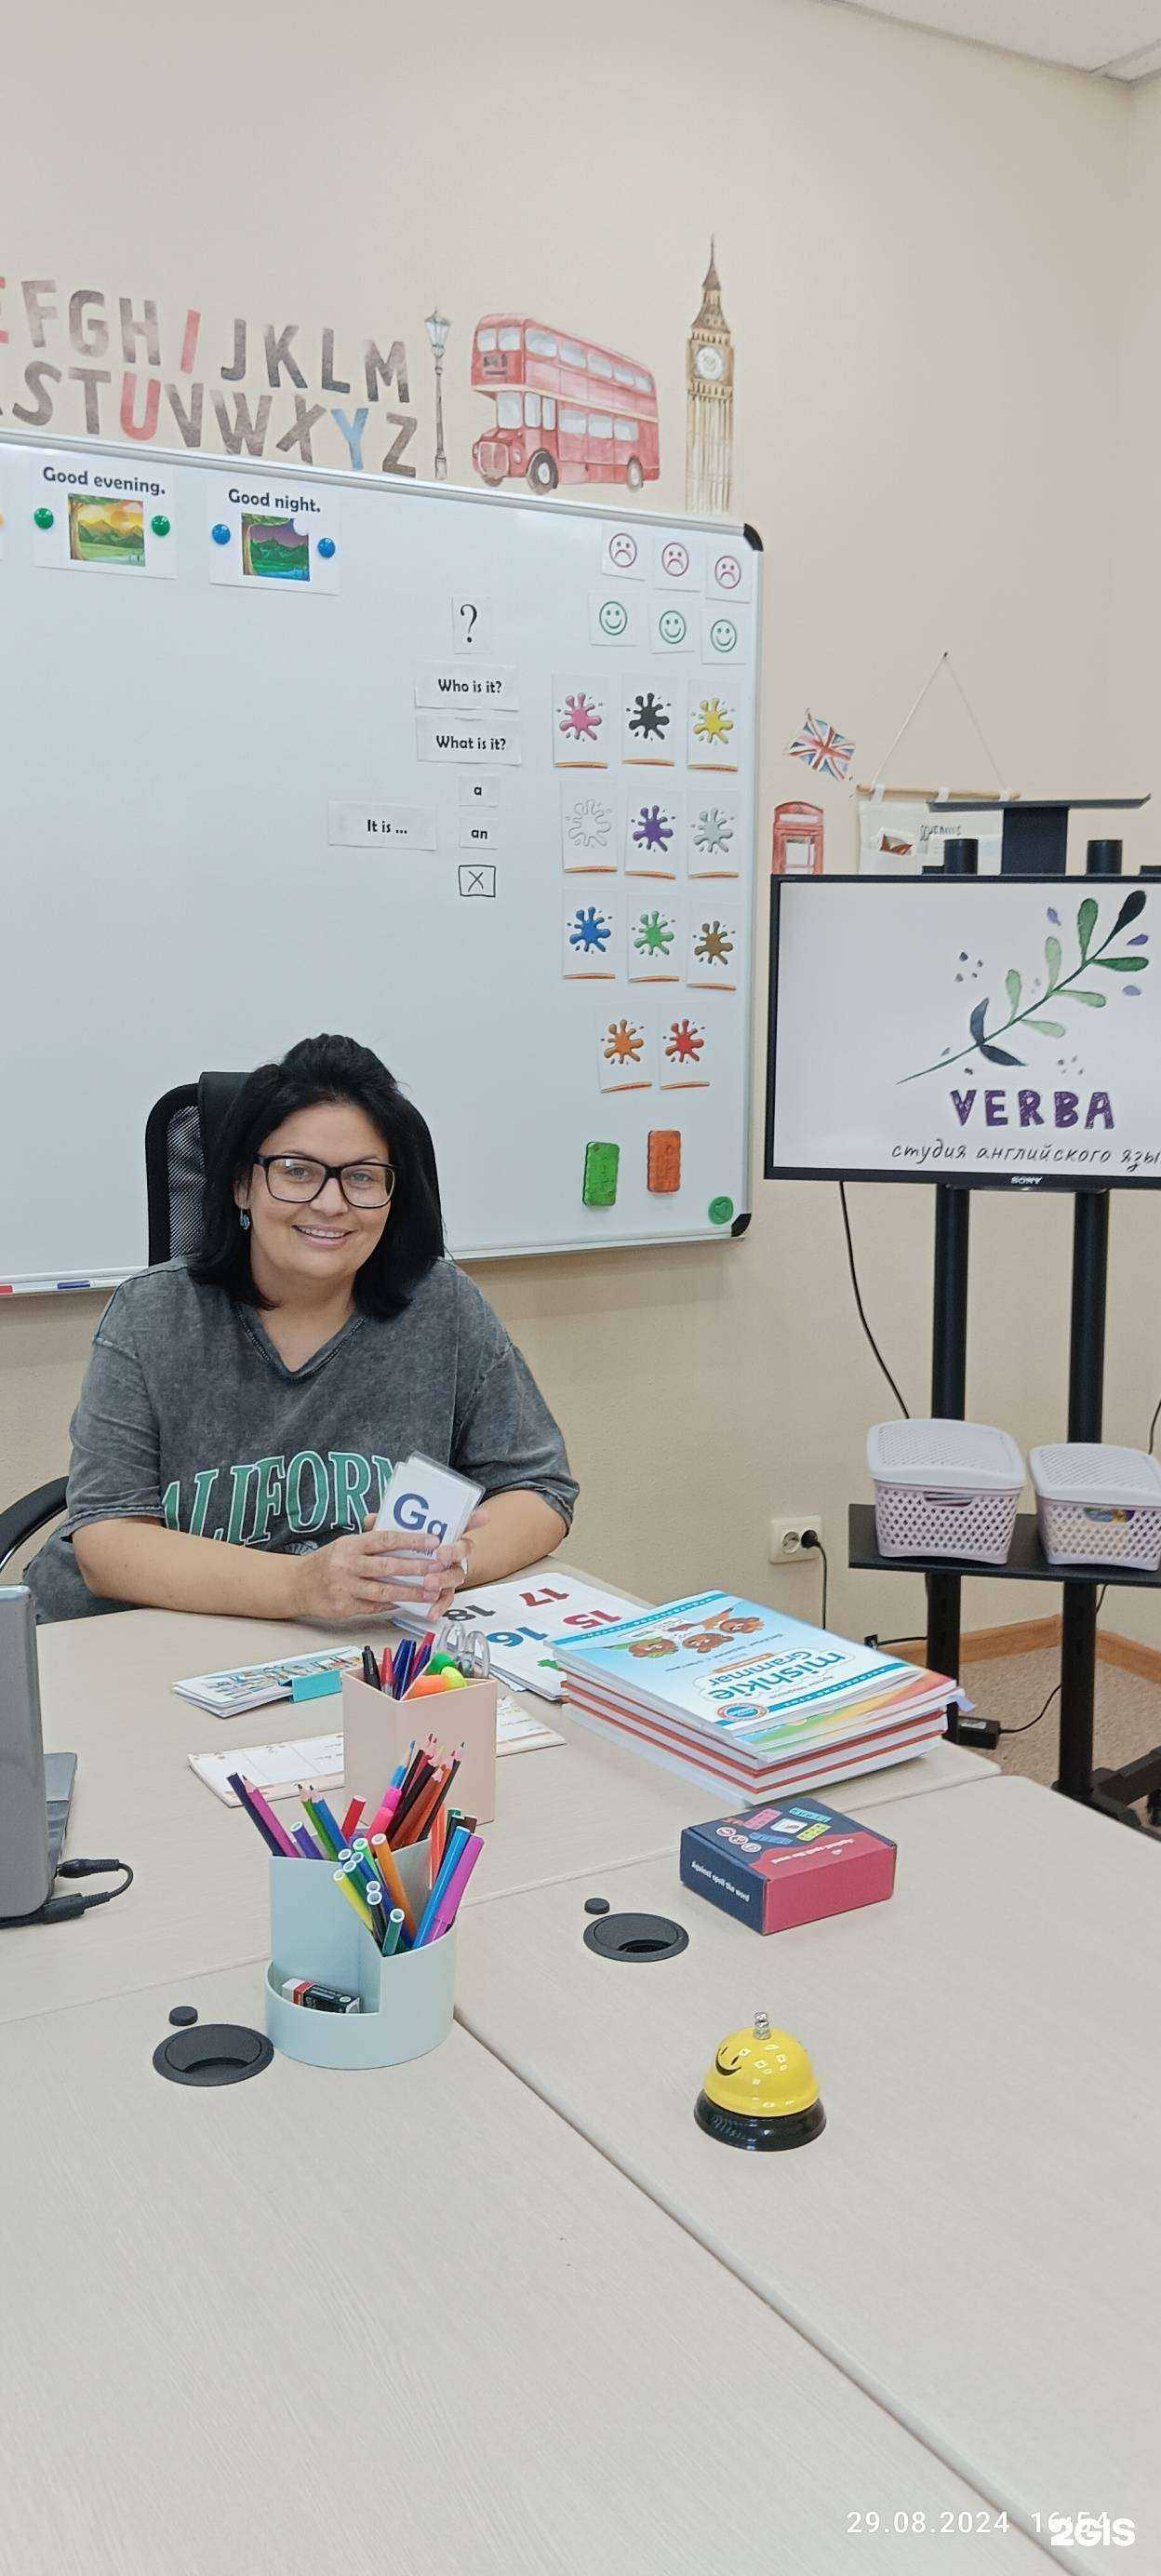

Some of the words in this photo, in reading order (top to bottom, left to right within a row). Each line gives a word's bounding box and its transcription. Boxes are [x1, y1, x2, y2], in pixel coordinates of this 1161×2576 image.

[43, 466, 88, 487] Good
[93, 472, 167, 495] evening.
[228, 489, 271, 508] Good
[274, 492, 322, 514] night.
[437, 678, 469, 693] Who
[473, 679, 483, 693] is
[486, 680, 502, 694] it?
[435, 735, 474, 750] What
[477, 736, 487, 750] is
[489, 737, 507, 751] it?
[474, 785, 483, 797] a
[367, 819, 378, 833] It
[381, 820, 392, 834] is
[471, 827, 488, 839] an
[950, 1090, 1115, 1129] VERBA
[891, 1138, 968, 1163] студия
[976, 1144, 1112, 1163] английского
[1010, 1175, 1043, 1186] SONY
[393, 1493, 448, 1546] Gg
[519, 1588, 570, 1607] 17
[442, 1604, 497, 1622] 18
[562, 1609, 622, 1630] 15
[486, 1626, 549, 1647] 16
[707, 1651, 847, 1700] mishkie
